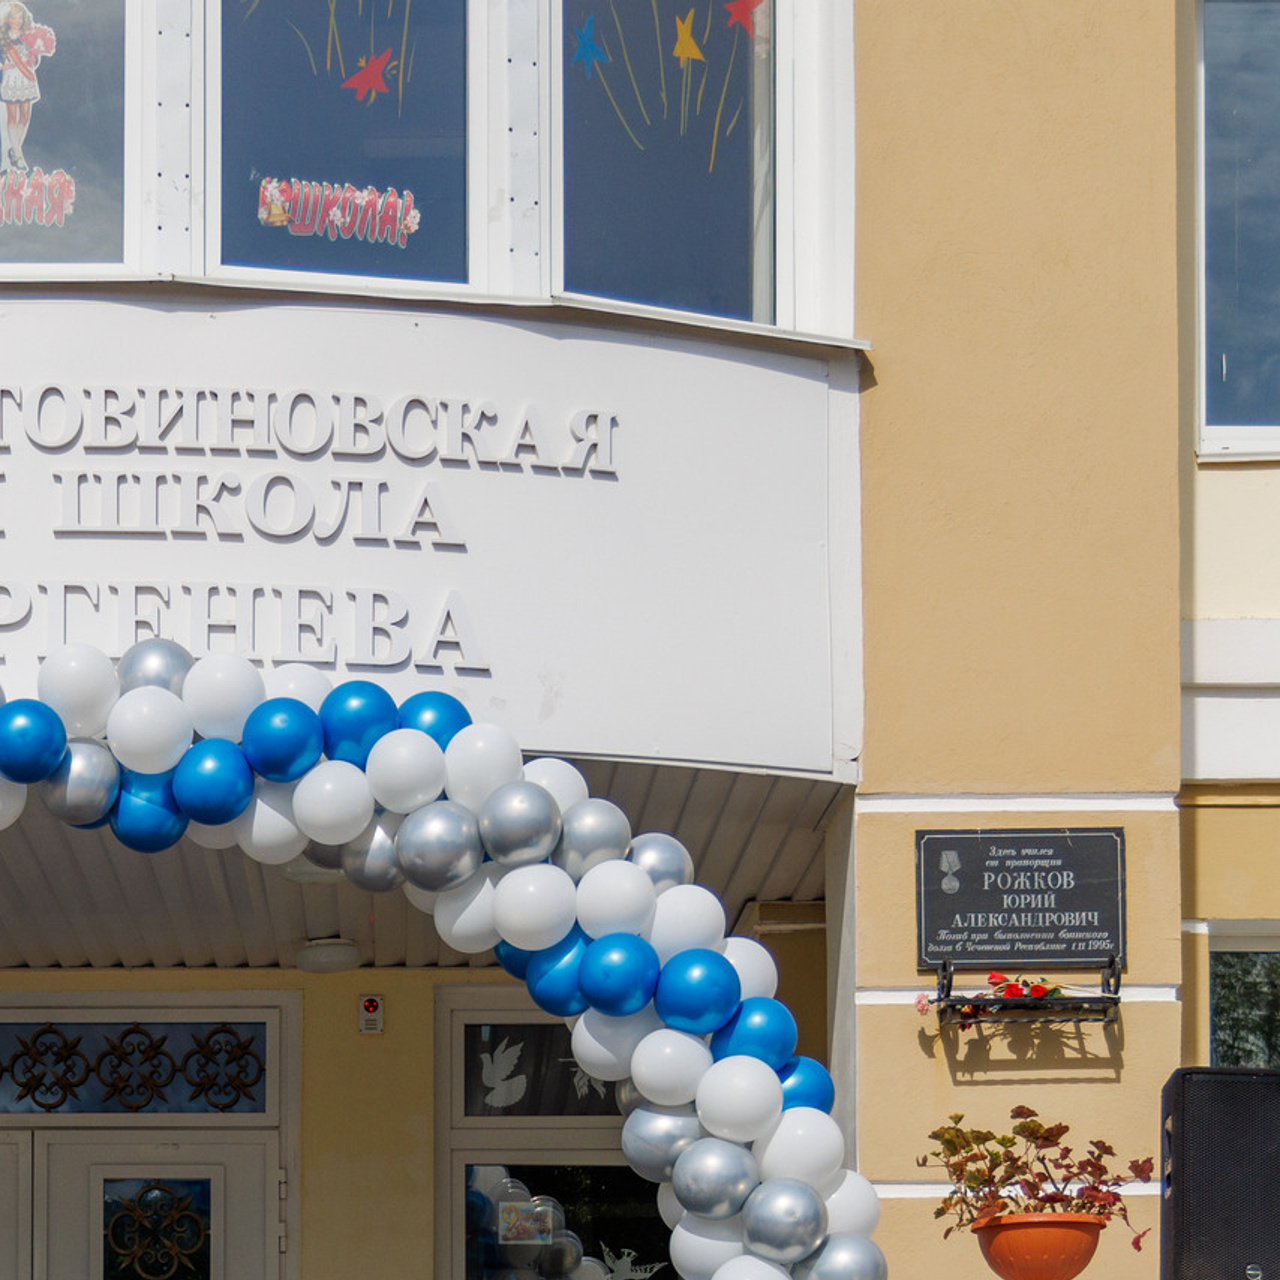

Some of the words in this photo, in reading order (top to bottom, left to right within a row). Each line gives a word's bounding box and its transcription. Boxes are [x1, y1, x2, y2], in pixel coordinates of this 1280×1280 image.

[288, 178, 415, 249] ШКОЛА!
[52, 470, 468, 553] ШКОЛА
[982, 870, 1075, 890] РОЖКОВ
[1002, 891, 1056, 909] ЮРИЙ
[951, 911, 1099, 928] АЛЕКСАНДРОВИЧ
[936, 929, 968, 940] Погиб
[970, 932, 989, 943] при
[993, 929, 1055, 940] выполнении
[1058, 928, 1109, 940] воинского
[955, 940, 962, 951] в
[1014, 940, 1067, 951] Республике
